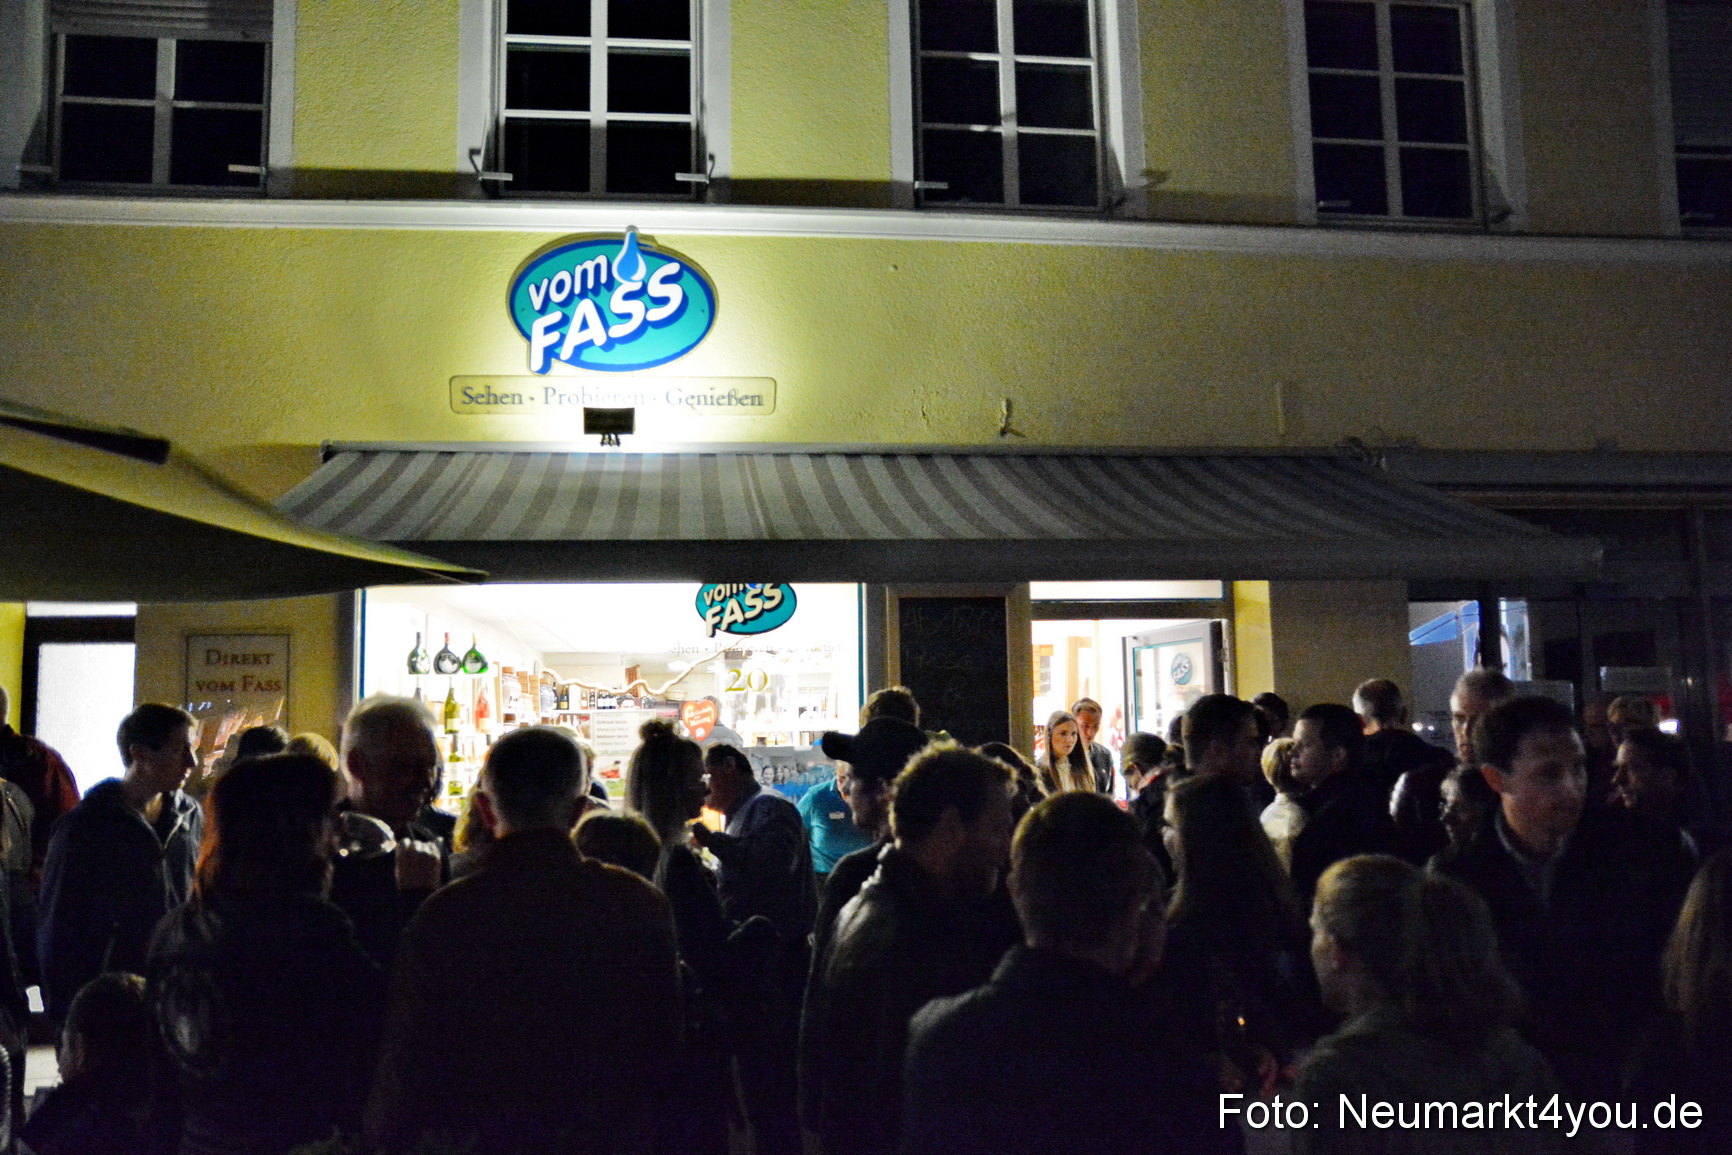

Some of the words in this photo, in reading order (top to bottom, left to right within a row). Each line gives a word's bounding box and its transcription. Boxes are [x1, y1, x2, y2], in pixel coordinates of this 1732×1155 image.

[528, 254, 609, 312] vom
[530, 262, 683, 373] FASS
[462, 386, 524, 405] Sehen
[543, 386, 645, 405] Probieren
[665, 387, 764, 406] Genießen
[705, 583, 783, 638] FASS
